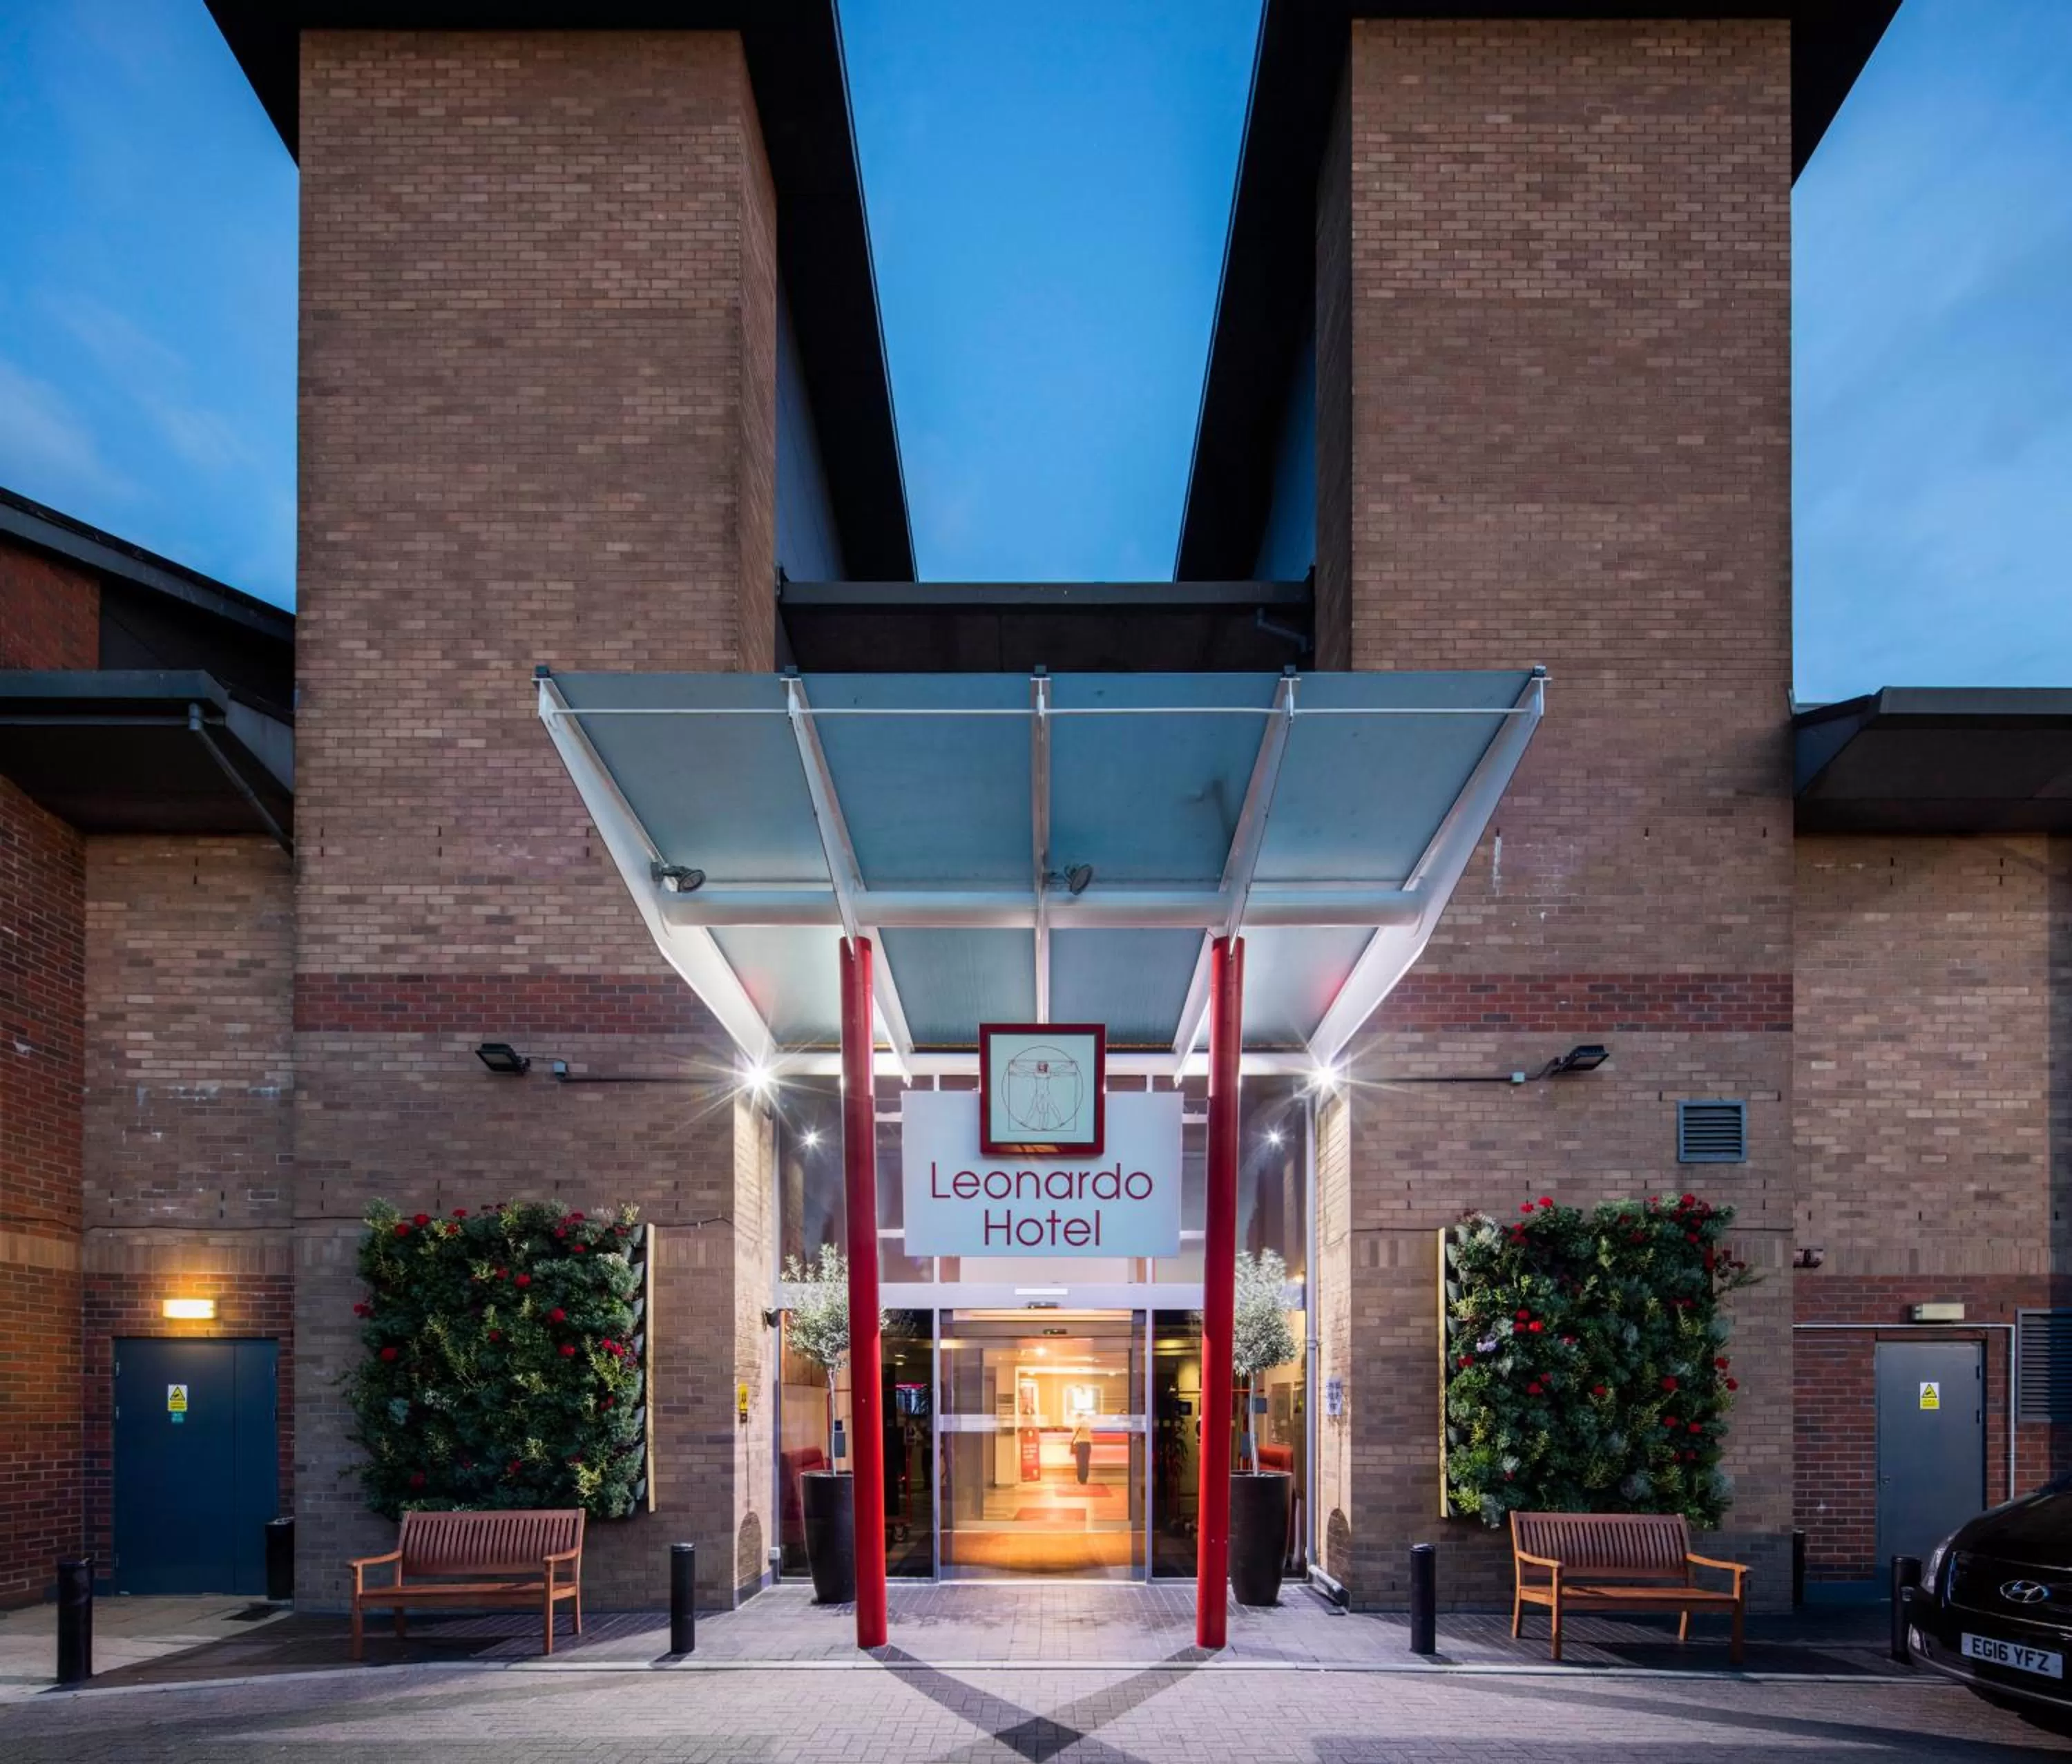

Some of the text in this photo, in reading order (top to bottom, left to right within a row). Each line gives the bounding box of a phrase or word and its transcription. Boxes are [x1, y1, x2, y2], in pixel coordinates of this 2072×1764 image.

[931, 1162, 1153, 1200] Leonardo
[984, 1209, 1100, 1246] Hotel
[1972, 1637, 2049, 1672] EG16 YFZ
